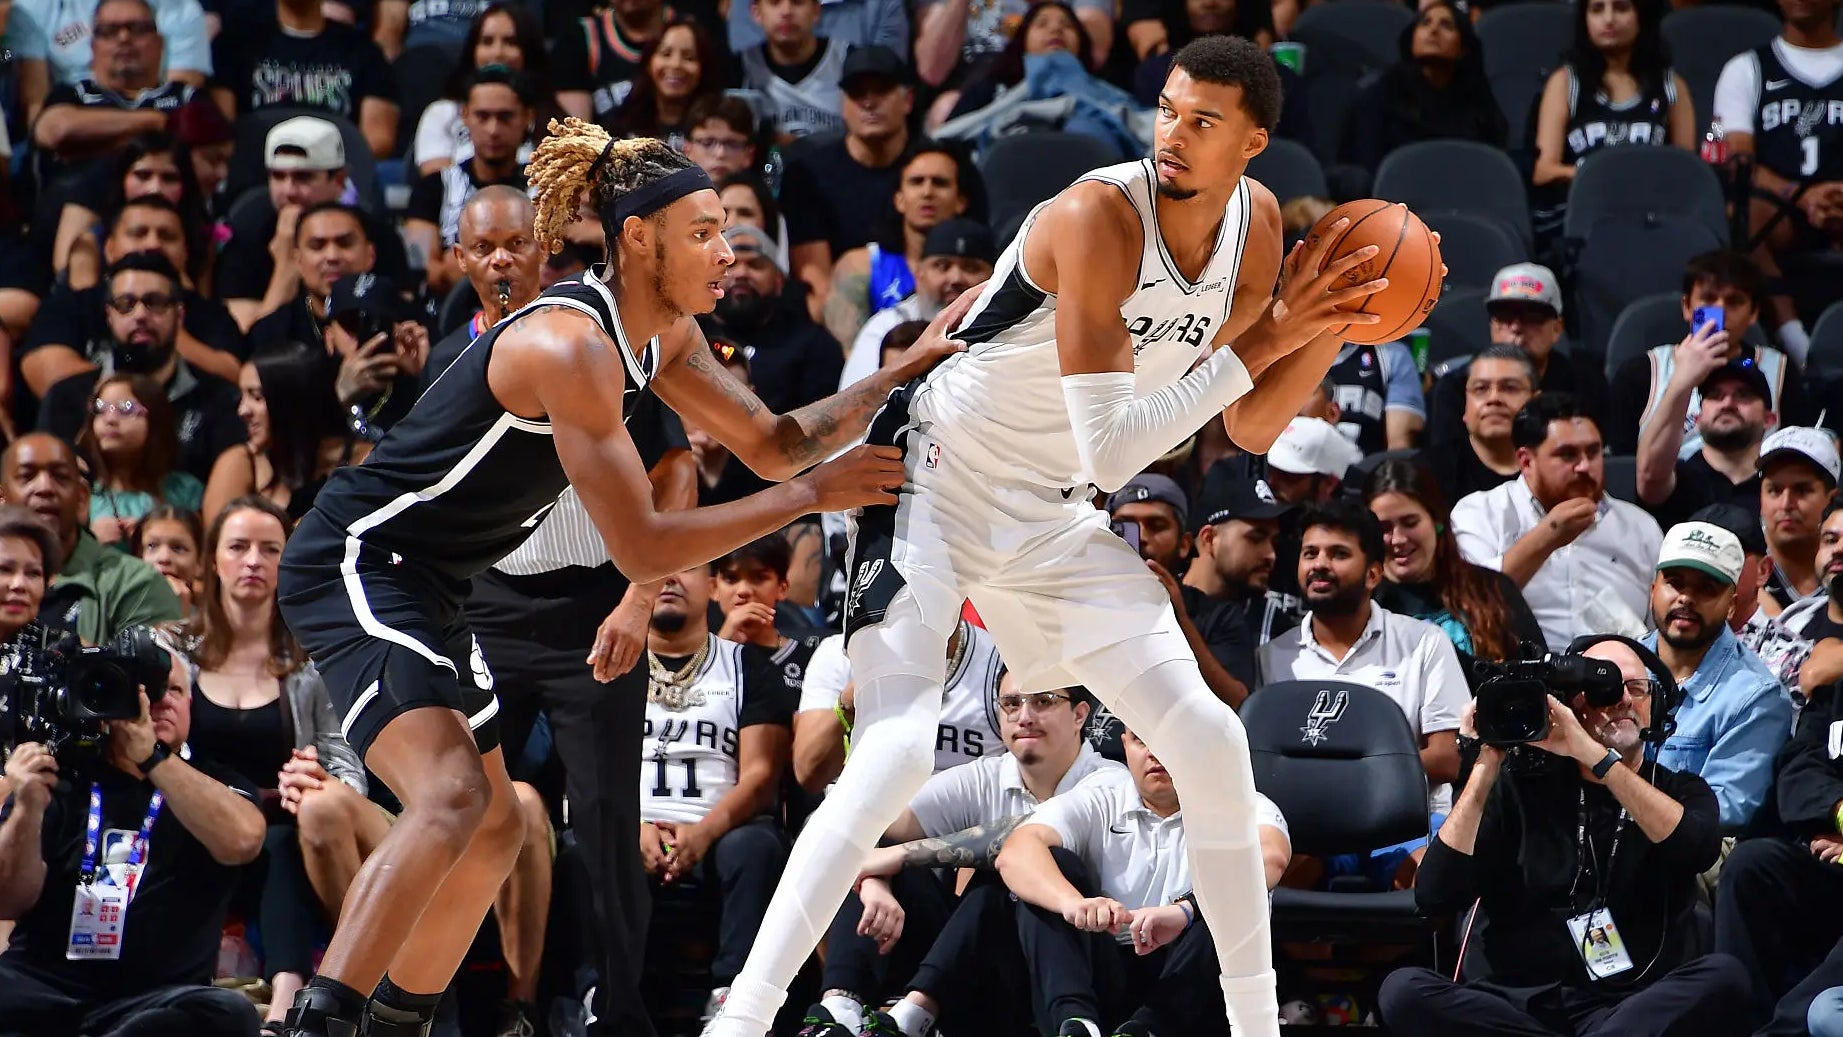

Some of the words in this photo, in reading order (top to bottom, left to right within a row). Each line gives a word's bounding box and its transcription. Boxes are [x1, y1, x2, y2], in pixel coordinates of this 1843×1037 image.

[1762, 99, 1843, 137] SPUR
[1801, 136, 1818, 175] 1
[1201, 282, 1222, 292] LEDGER
[1123, 314, 1211, 354] PURS
[644, 719, 738, 759] URS
[652, 759, 702, 797] 11
